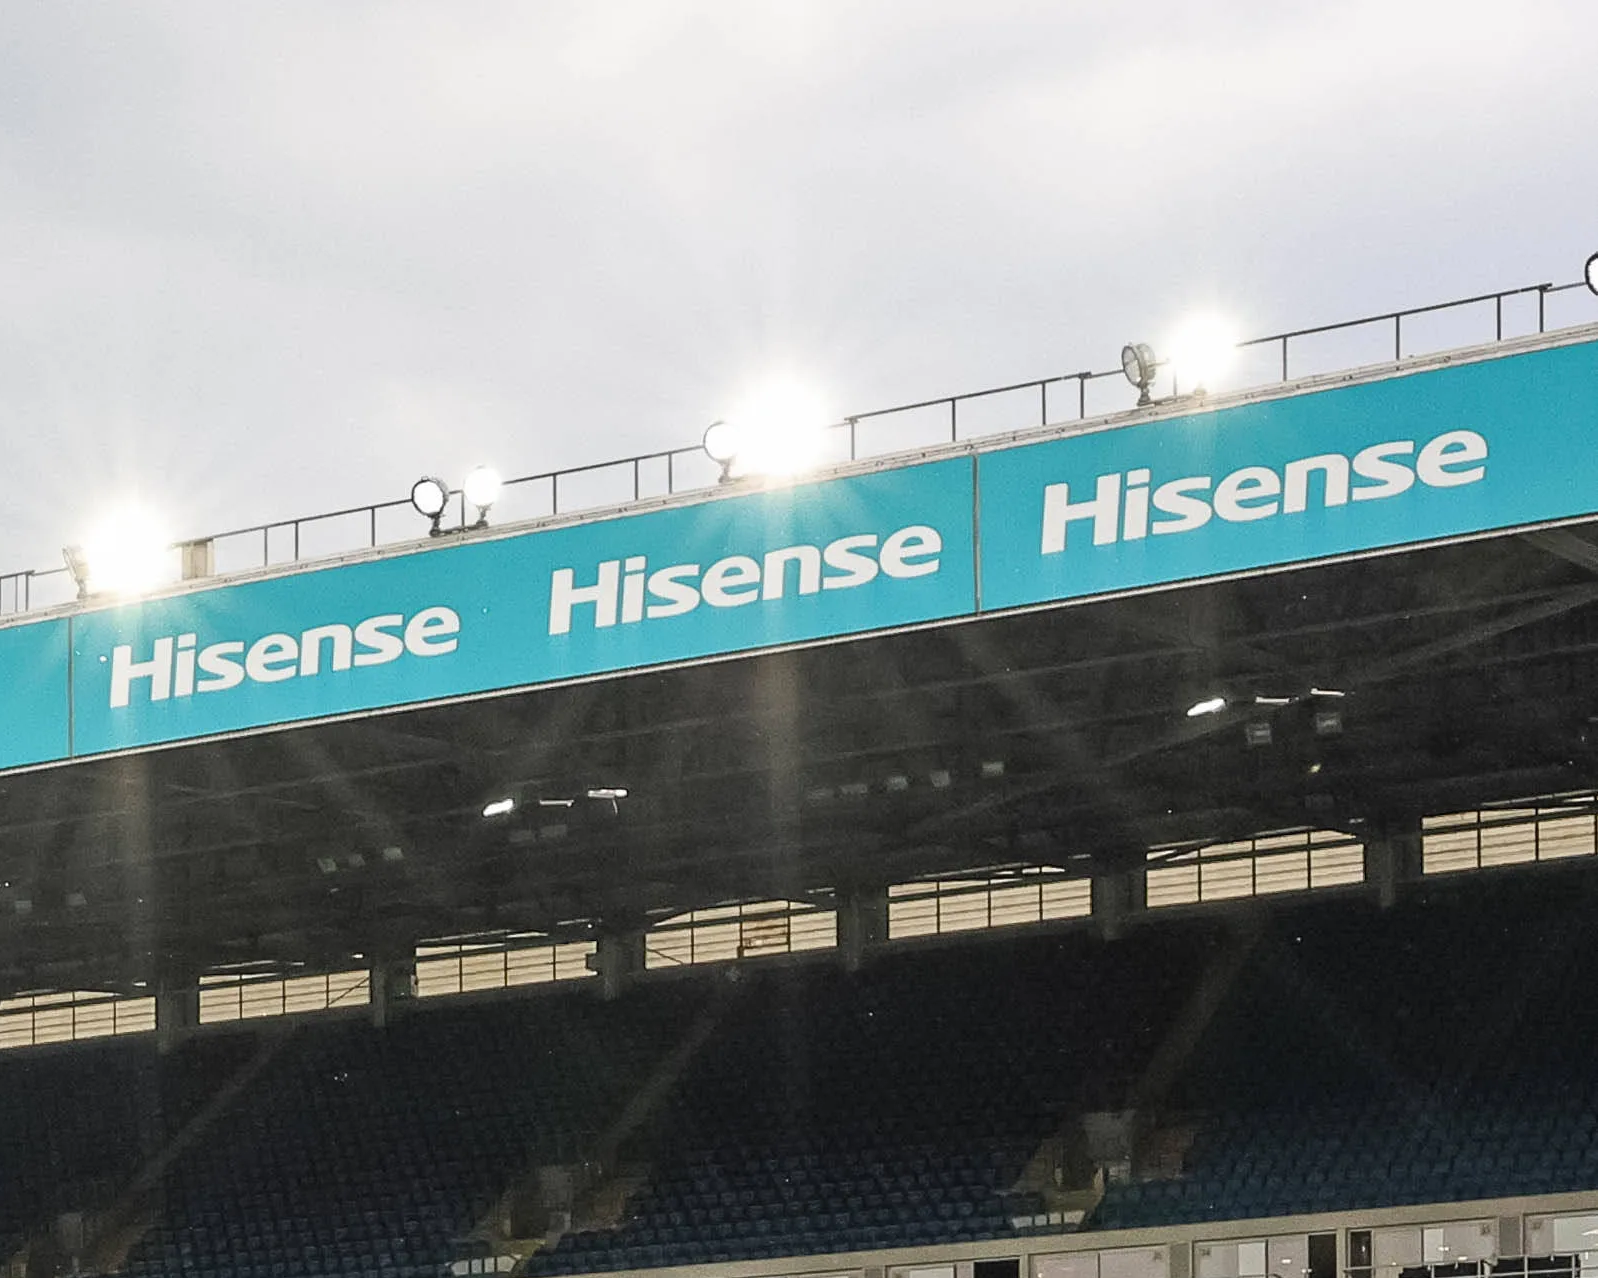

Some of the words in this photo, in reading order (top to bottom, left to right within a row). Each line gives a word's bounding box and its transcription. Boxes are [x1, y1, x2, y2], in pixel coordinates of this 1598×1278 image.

[1042, 431, 1487, 554] Hisense
[549, 526, 941, 635] Hisense
[110, 607, 459, 710] Hisense
